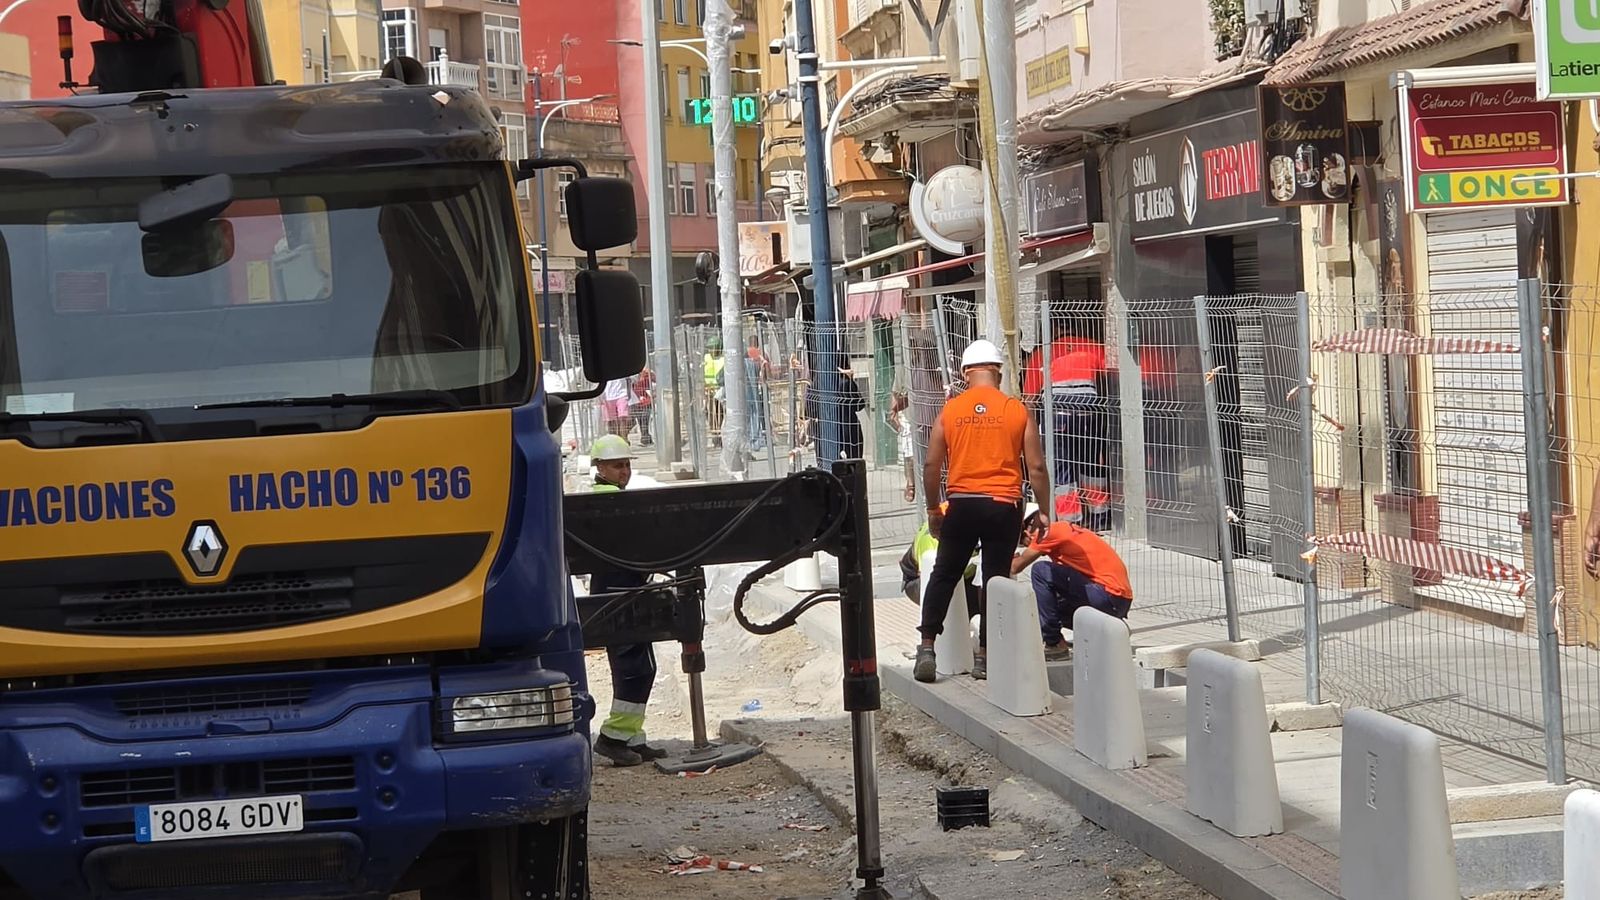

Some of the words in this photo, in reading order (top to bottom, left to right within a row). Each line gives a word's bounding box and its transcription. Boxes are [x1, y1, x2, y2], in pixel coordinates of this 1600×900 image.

[1419, 93, 1466, 110] Estanco
[1470, 91, 1500, 108] Mari
[1503, 89, 1538, 106] Carm
[1265, 120, 1344, 141] Amira
[1448, 131, 1541, 149] TABACOS
[1132, 147, 1157, 187] SALÓN
[1201, 140, 1260, 201] TERRAM
[1458, 172, 1552, 199] ONCE
[931, 207, 984, 224] Cruzcam
[1134, 192, 1146, 222] DE
[1146, 187, 1175, 220] JUEGOS
[228, 468, 358, 512] HACHO
[368, 469, 404, 504] Nº
[411, 466, 471, 501] 136
[140, 826, 147, 835] E
[161, 806, 230, 834] 8084
[241, 802, 291, 828] GDV
